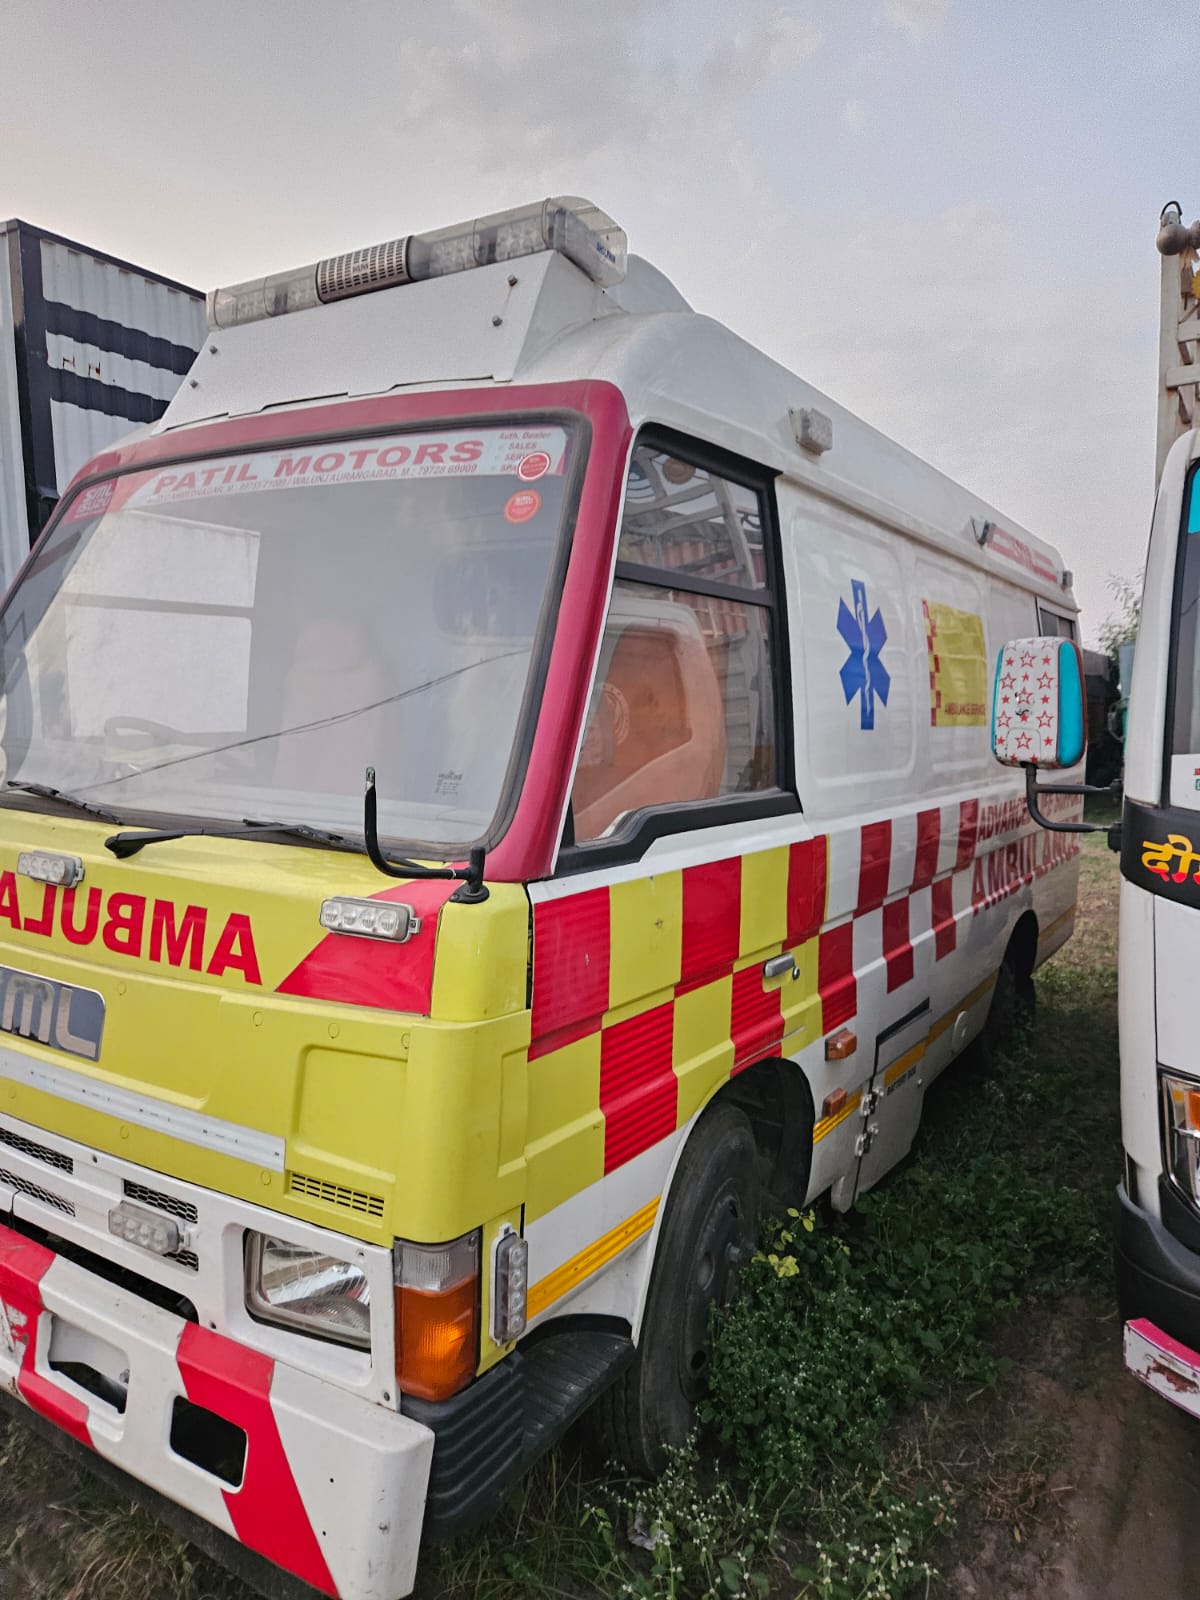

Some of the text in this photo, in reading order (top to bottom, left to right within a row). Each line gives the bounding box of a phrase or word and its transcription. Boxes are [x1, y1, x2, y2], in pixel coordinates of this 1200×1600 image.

[508, 442, 537, 450] SALES
[152, 463, 257, 495] PATIL
[273, 440, 484, 478] MOTORS
